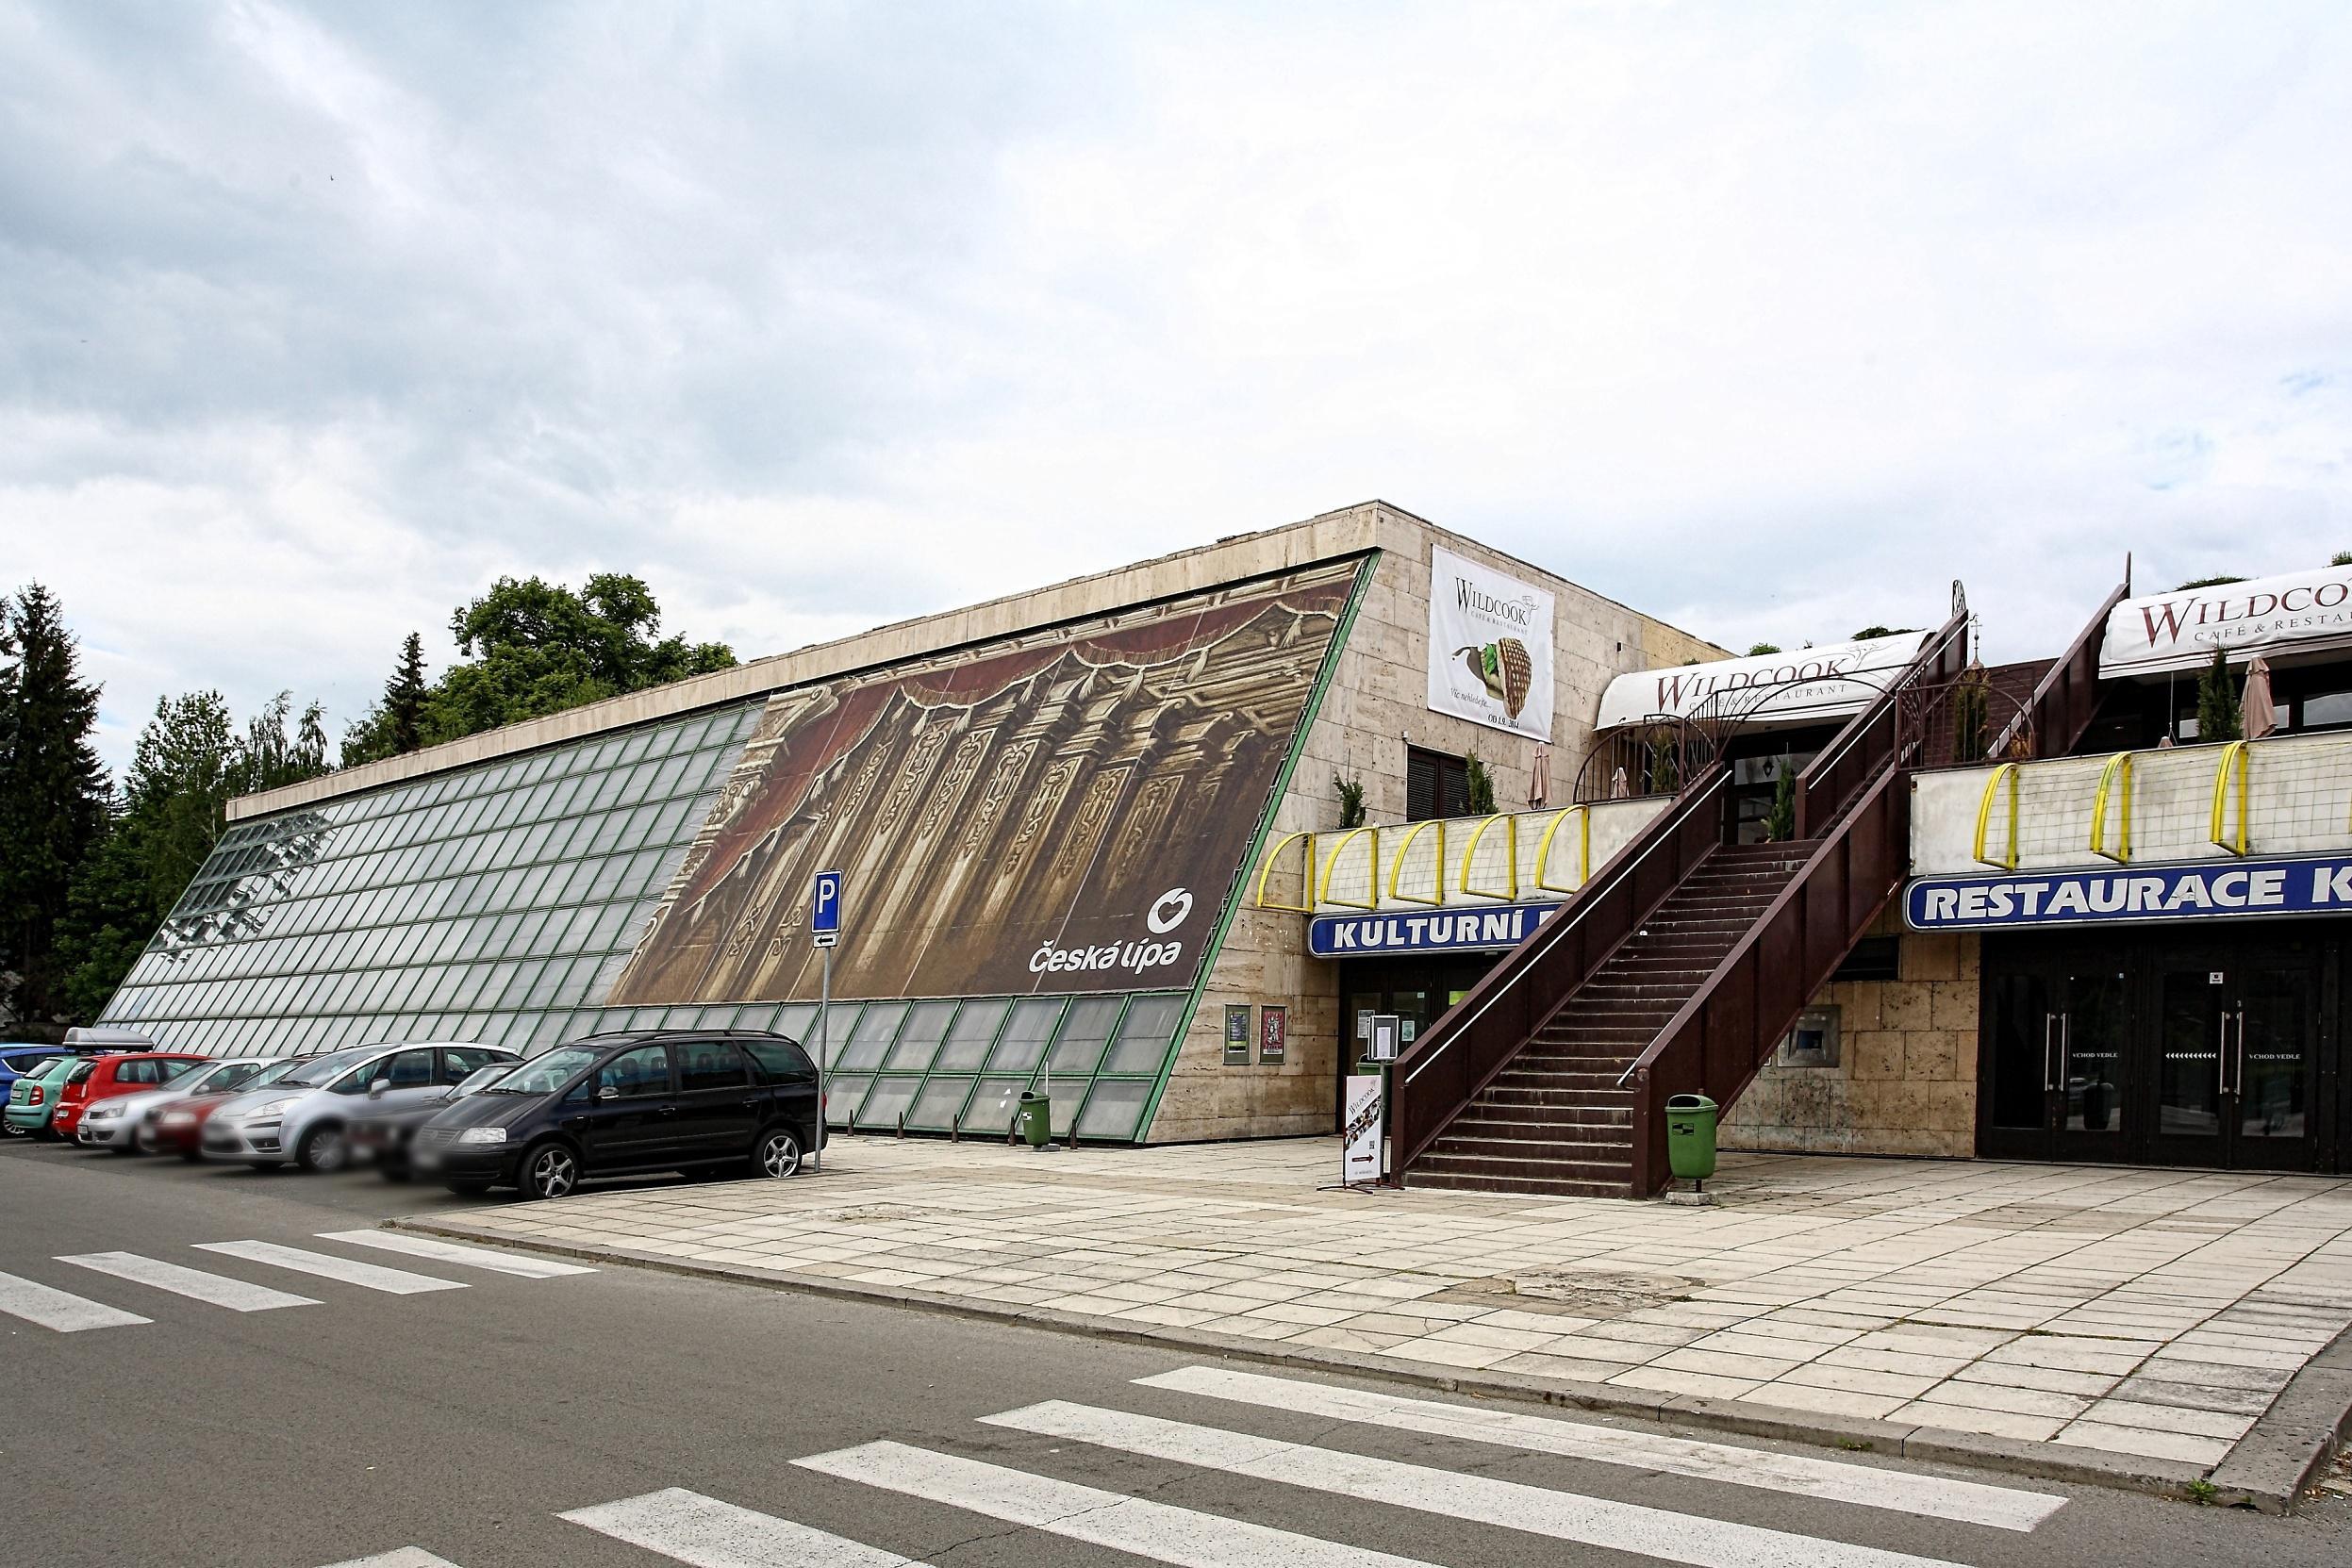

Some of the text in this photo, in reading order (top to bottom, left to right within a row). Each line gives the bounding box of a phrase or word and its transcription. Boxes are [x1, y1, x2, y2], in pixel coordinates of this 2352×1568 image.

[1455, 577, 1528, 626] WILDCOOK
[2139, 583, 2348, 649] WILDCO
[2195, 623, 2246, 642] CAFÉ
[2254, 623, 2265, 634] &
[1657, 658, 1848, 714] WILDCOOK
[1730, 697, 1738, 706] &
[819, 879, 836, 914] P
[1924, 869, 2287, 921] RESTAURACE
[1333, 909, 1525, 949] KULTURNÍ
